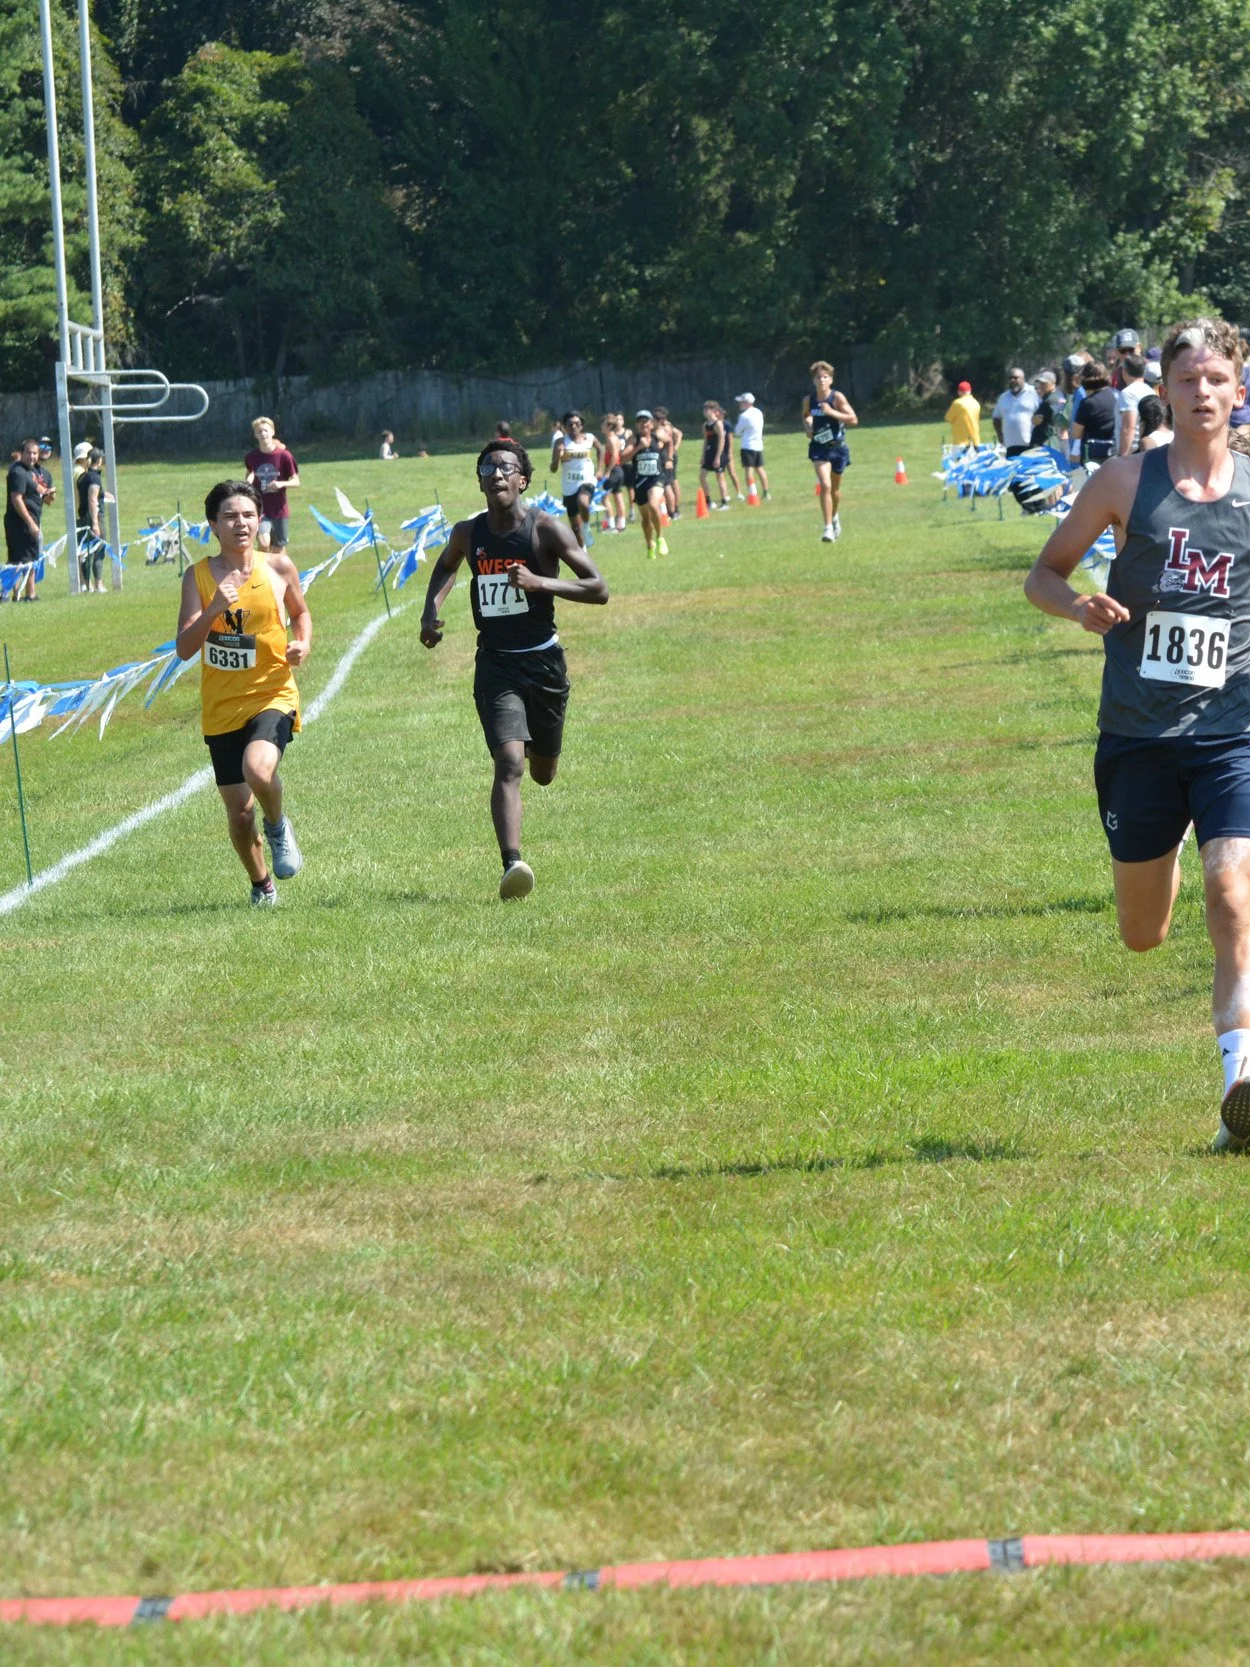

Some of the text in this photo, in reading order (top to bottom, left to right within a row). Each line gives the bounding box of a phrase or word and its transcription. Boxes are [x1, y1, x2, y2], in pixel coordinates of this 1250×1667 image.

[1164, 527, 1235, 599] LM
[480, 582, 525, 606] 1771
[209, 646, 249, 669] 6331
[1146, 624, 1226, 670] 1836
